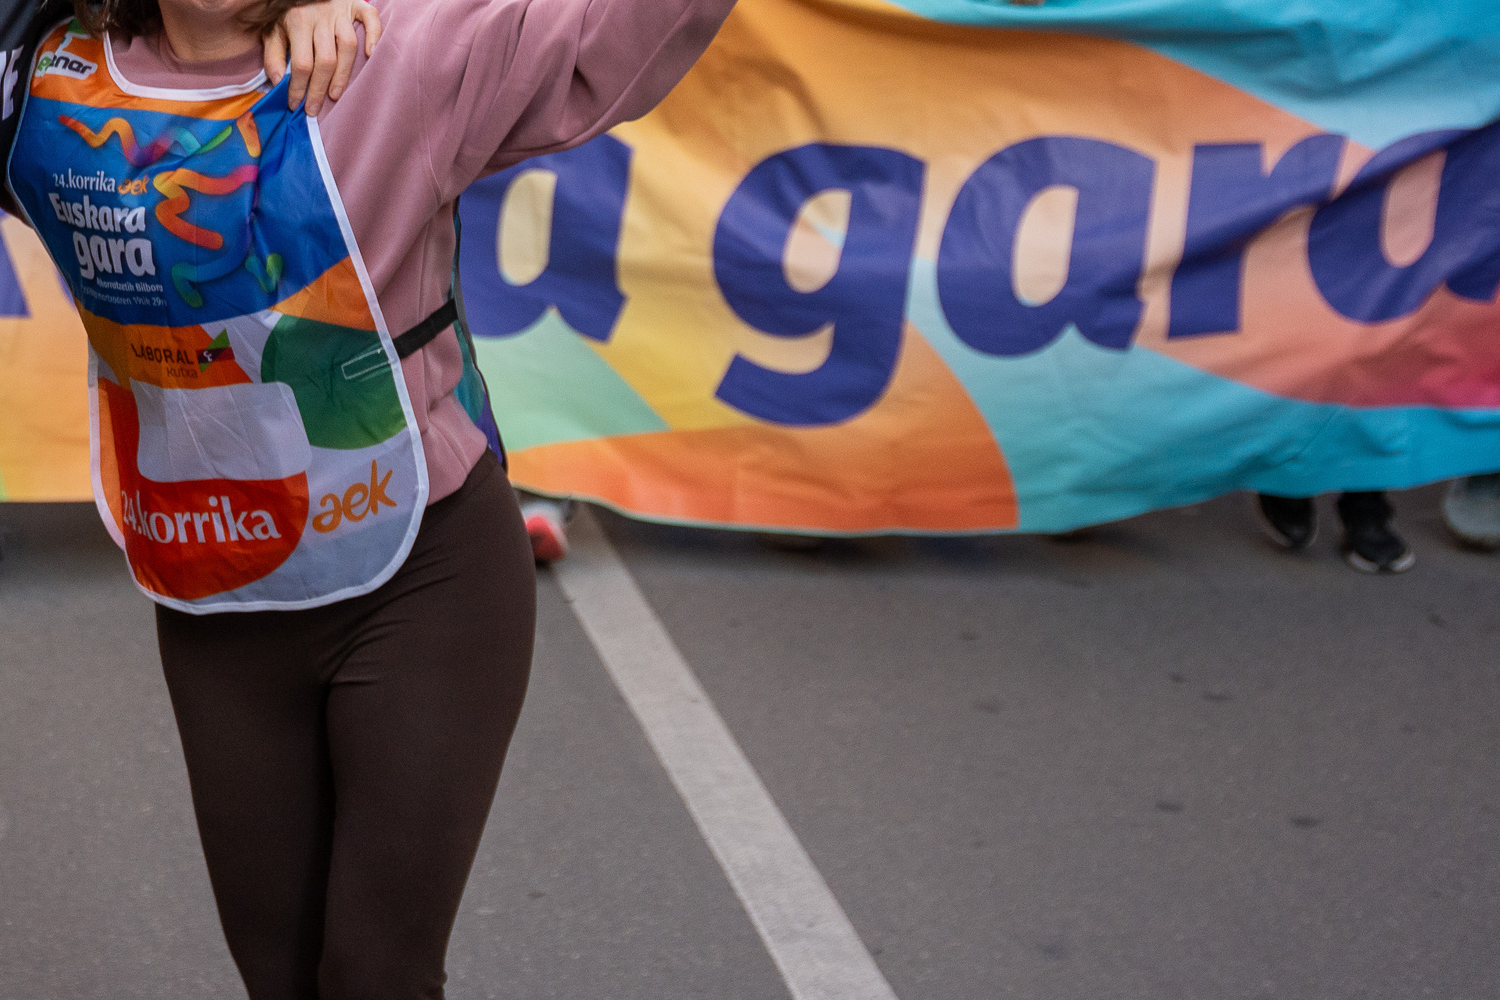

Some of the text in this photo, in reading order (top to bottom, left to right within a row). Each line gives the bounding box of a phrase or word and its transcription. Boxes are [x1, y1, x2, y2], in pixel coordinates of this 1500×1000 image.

[53, 168, 116, 193] 24.korrika
[49, 193, 147, 234] Euskara
[72, 230, 156, 281] gara
[713, 128, 1500, 428] gara
[130, 343, 195, 366] LABORAL
[121, 489, 282, 544] 24.korrika
